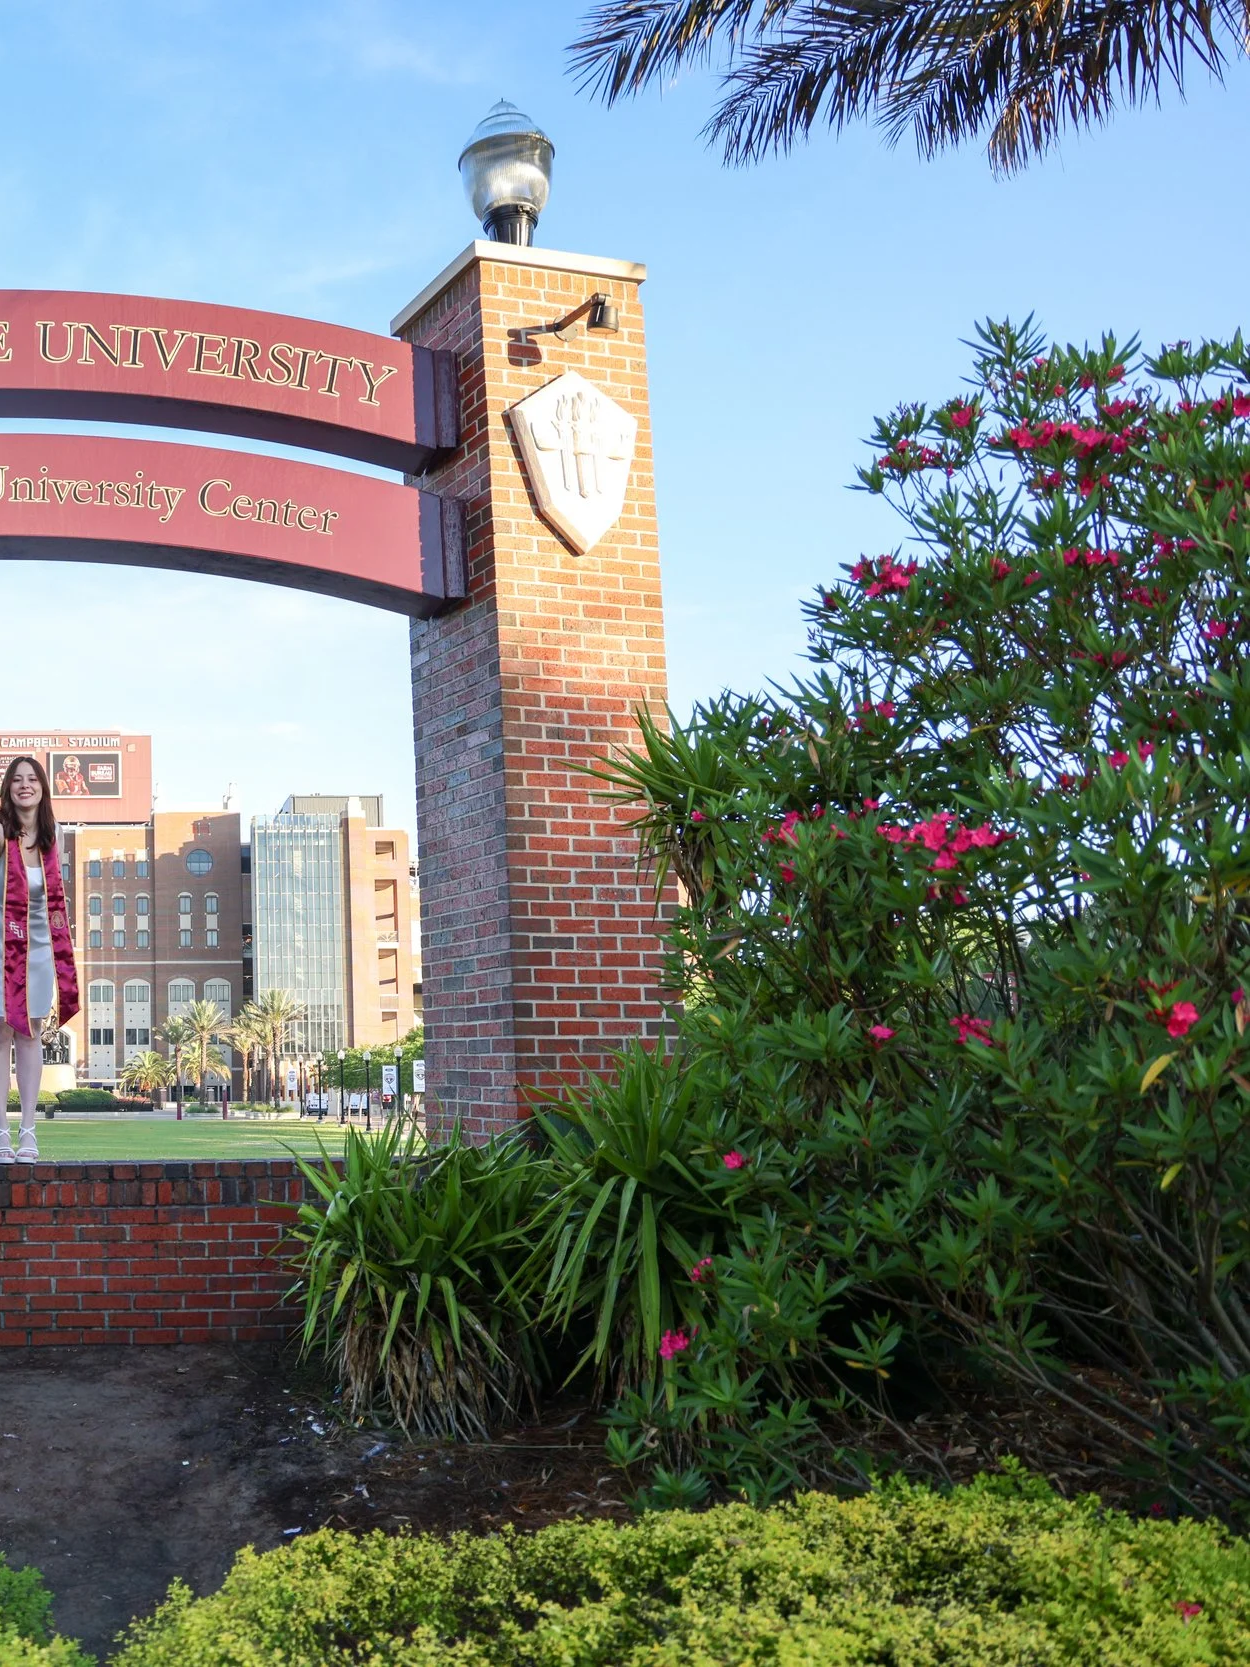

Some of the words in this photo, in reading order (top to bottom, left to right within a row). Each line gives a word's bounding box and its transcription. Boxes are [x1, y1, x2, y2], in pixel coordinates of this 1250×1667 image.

[35, 321, 398, 407] UNIVERSITY
[198, 478, 339, 535] Center
[0, 738, 63, 748] CAMPBELL
[68, 737, 121, 748] STADIUM
[8, 921, 25, 939] FSU
